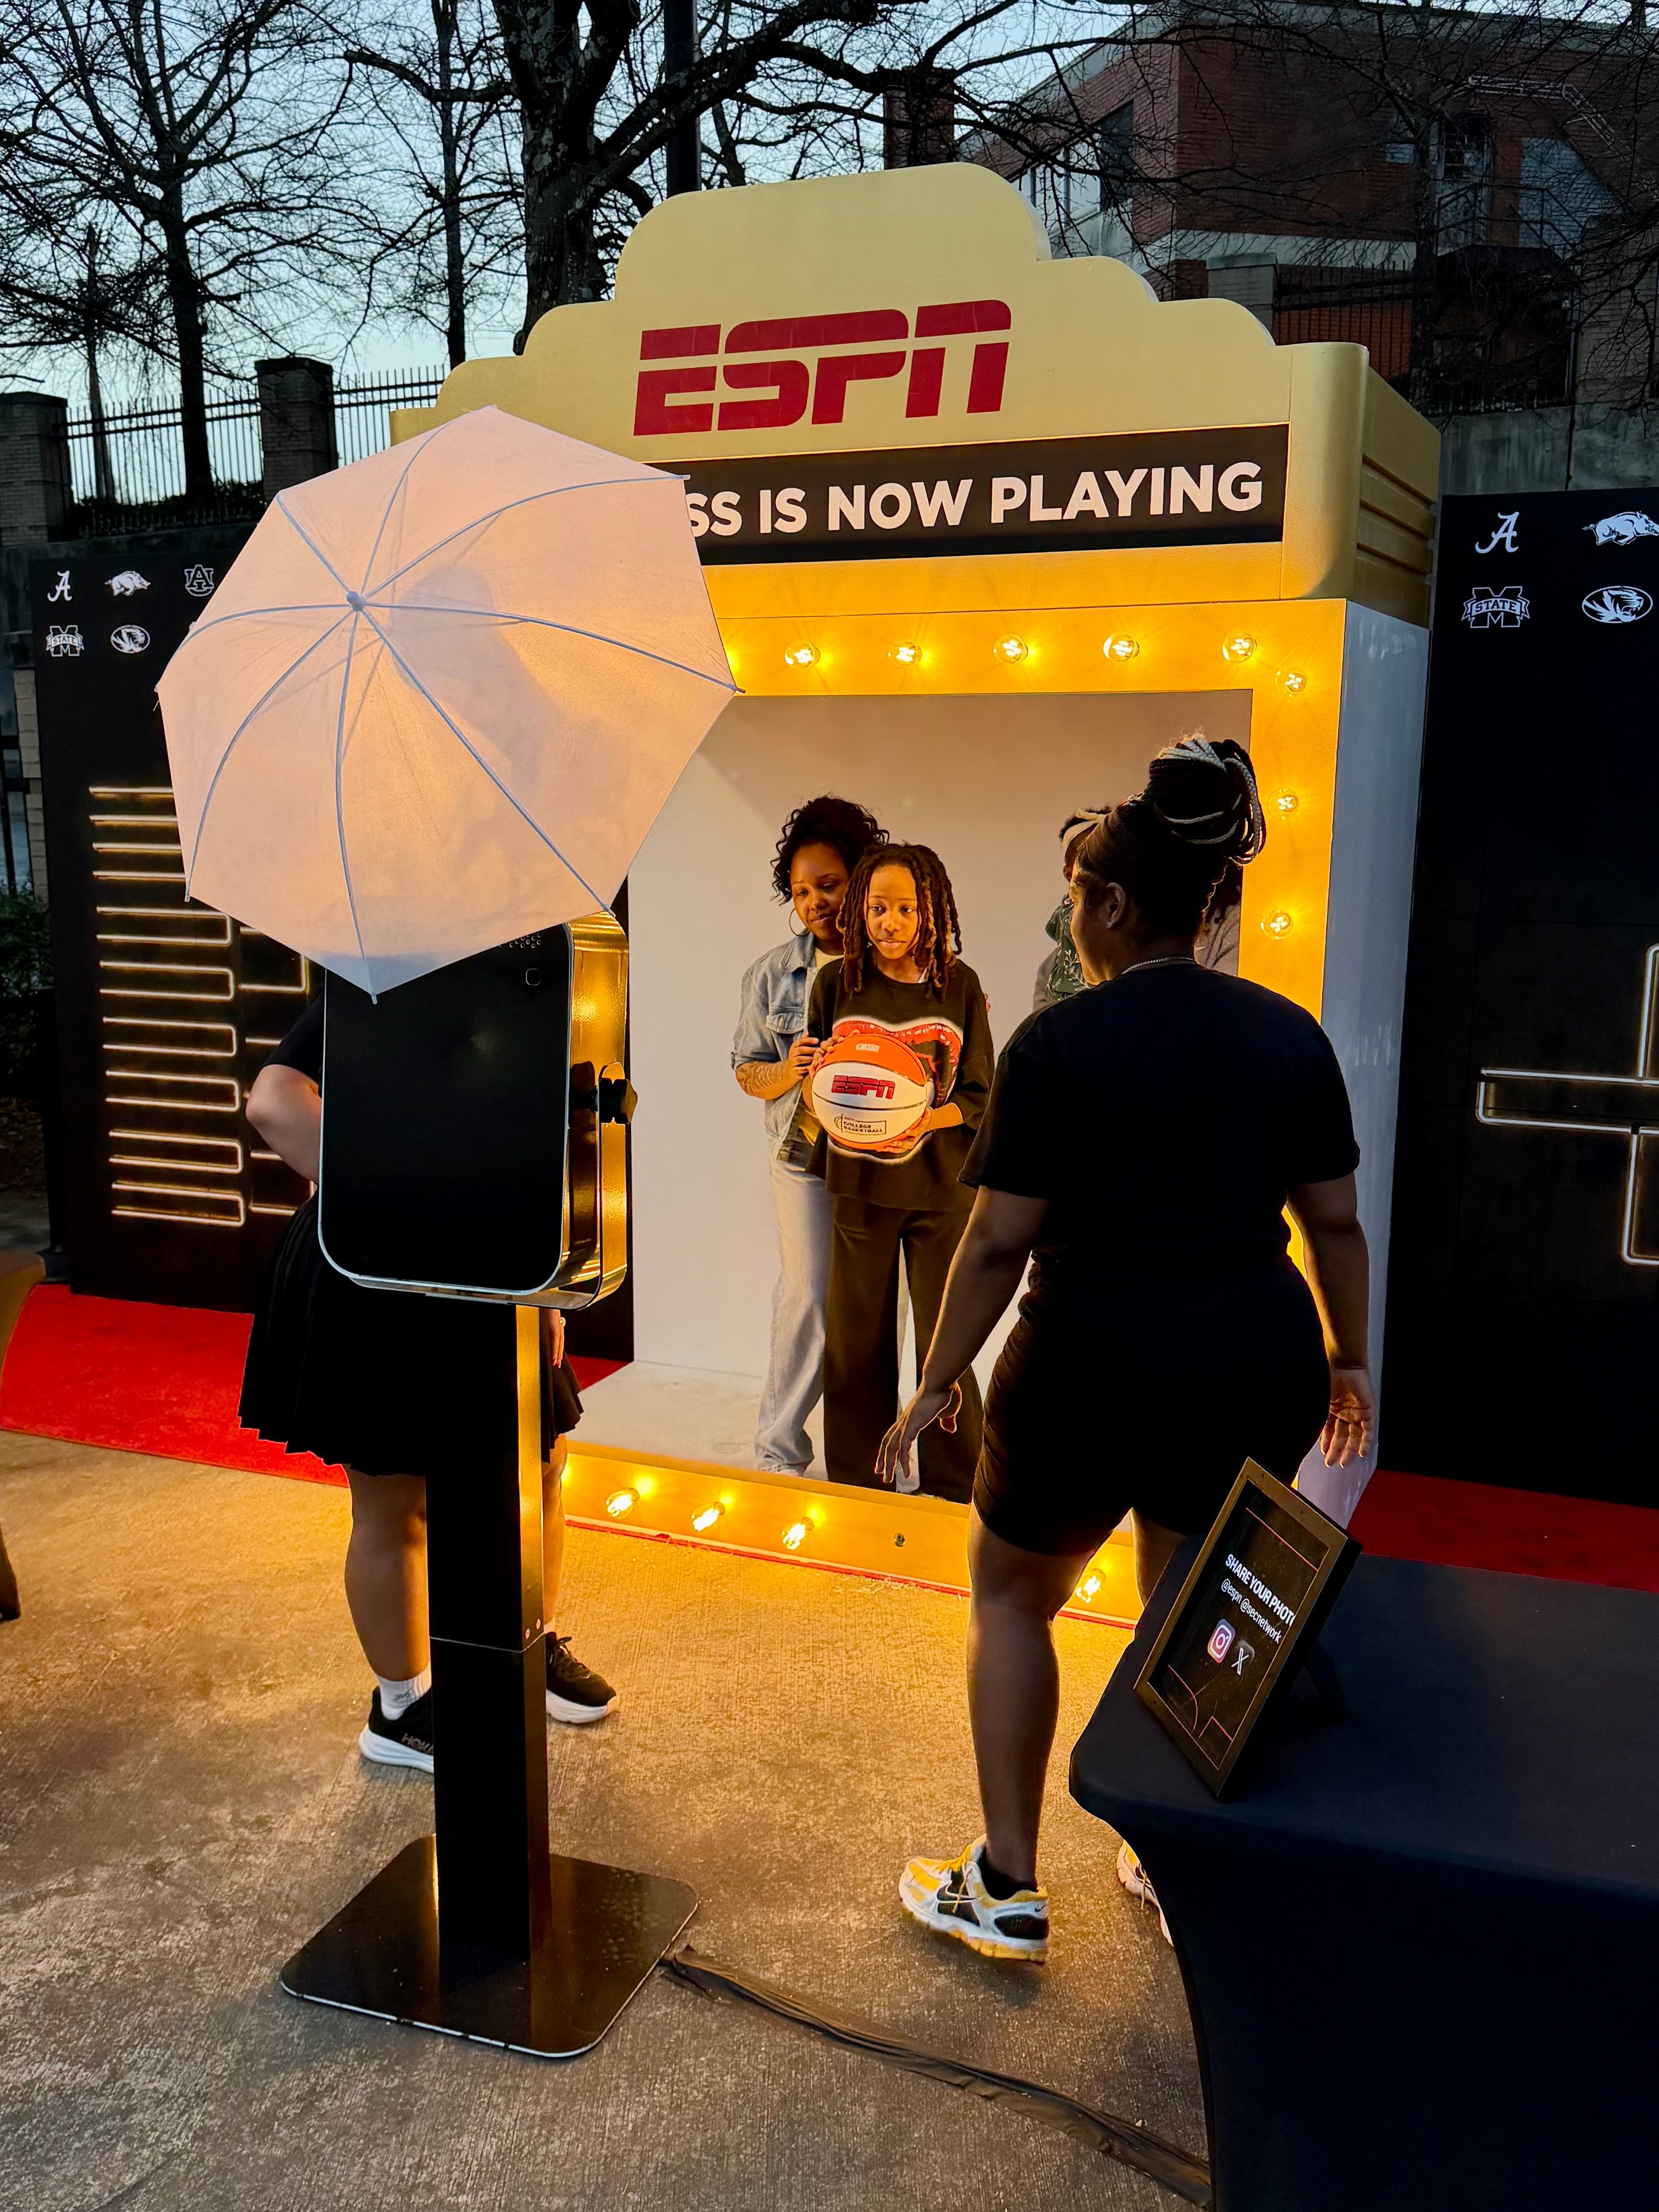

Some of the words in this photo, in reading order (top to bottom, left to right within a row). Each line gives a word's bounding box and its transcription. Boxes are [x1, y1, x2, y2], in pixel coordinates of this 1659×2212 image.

[633, 300, 1011, 436] ESPN
[760, 487, 807, 533] IS
[828, 479, 973, 531] NOW
[991, 462, 1262, 523] PLAYING
[1475, 511, 1520, 554] A
[47, 570, 72, 602] A
[1475, 599, 1517, 612] STATE
[53, 635, 77, 645] STATE
[831, 1075, 896, 1099] ESPN
[1225, 1554, 1252, 1585] SHARE
[1249, 1575, 1272, 1605] YOUR
[1221, 1578, 1242, 1604] @espn
[1240, 1598, 1281, 1644] @secnetwork
